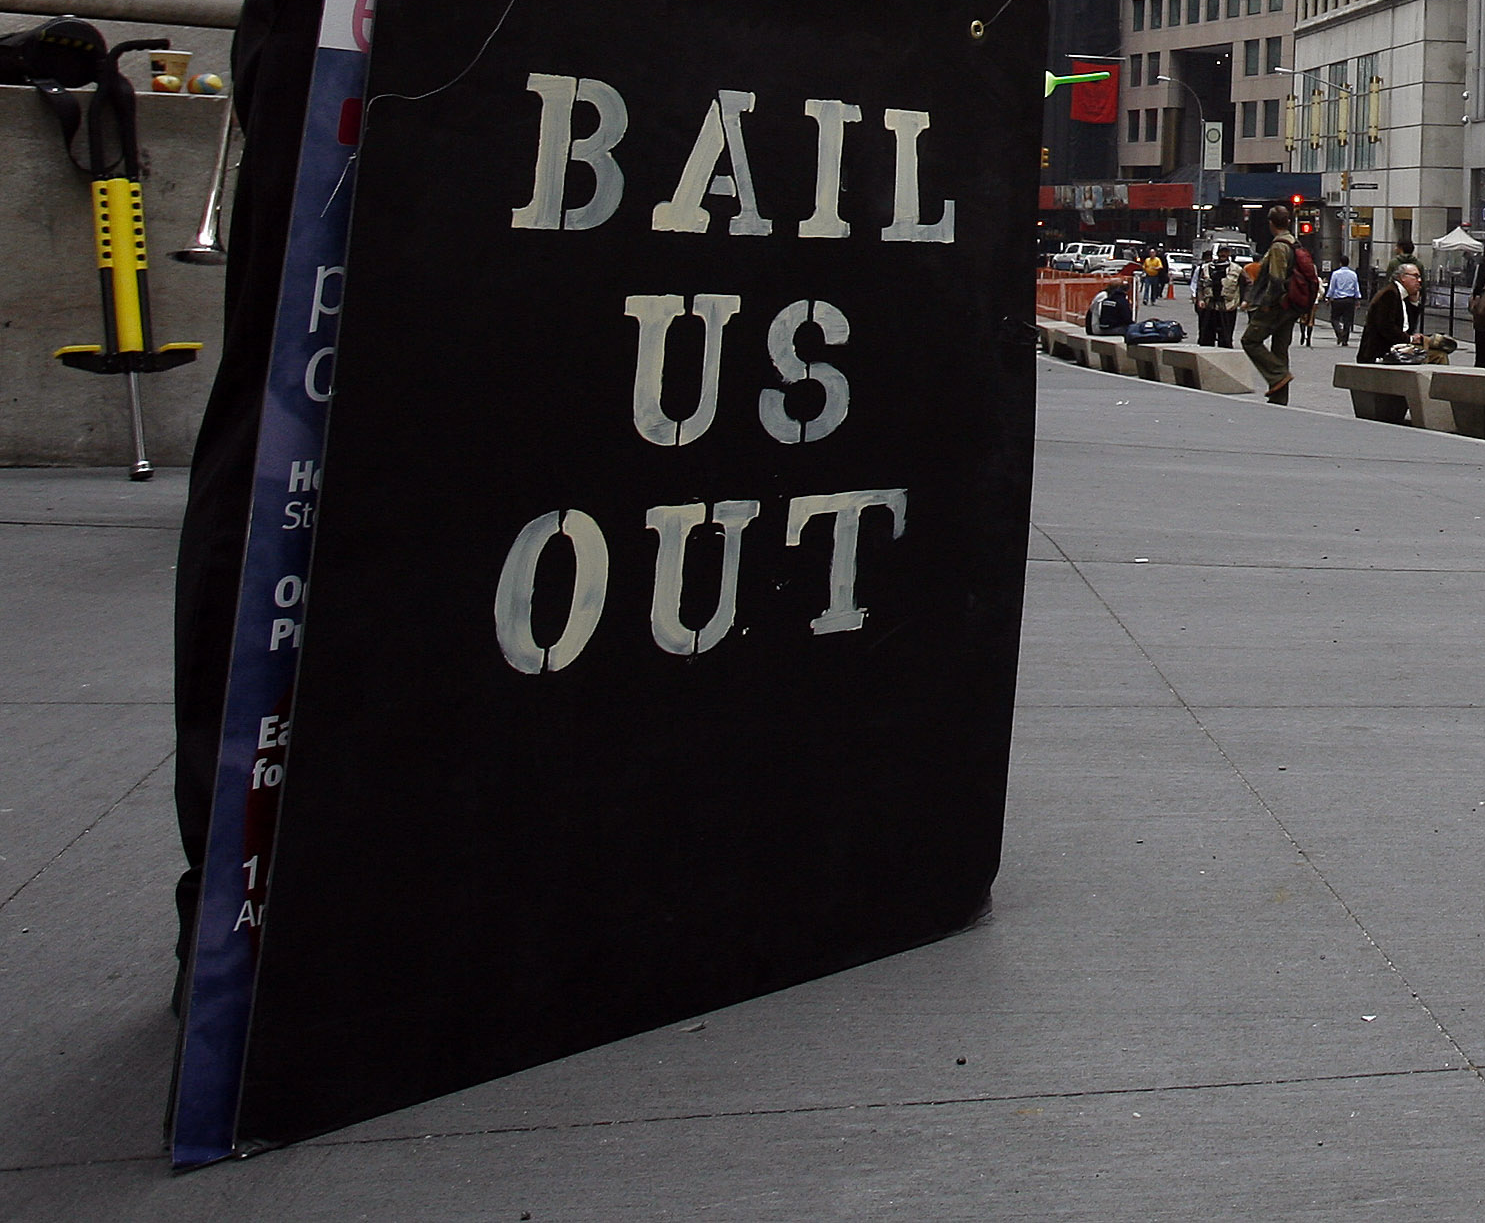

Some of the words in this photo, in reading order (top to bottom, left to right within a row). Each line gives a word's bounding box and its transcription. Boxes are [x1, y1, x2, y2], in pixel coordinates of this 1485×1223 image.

[511, 73, 955, 243] BAIL
[624, 294, 850, 446] US
[494, 488, 908, 674] OUT
